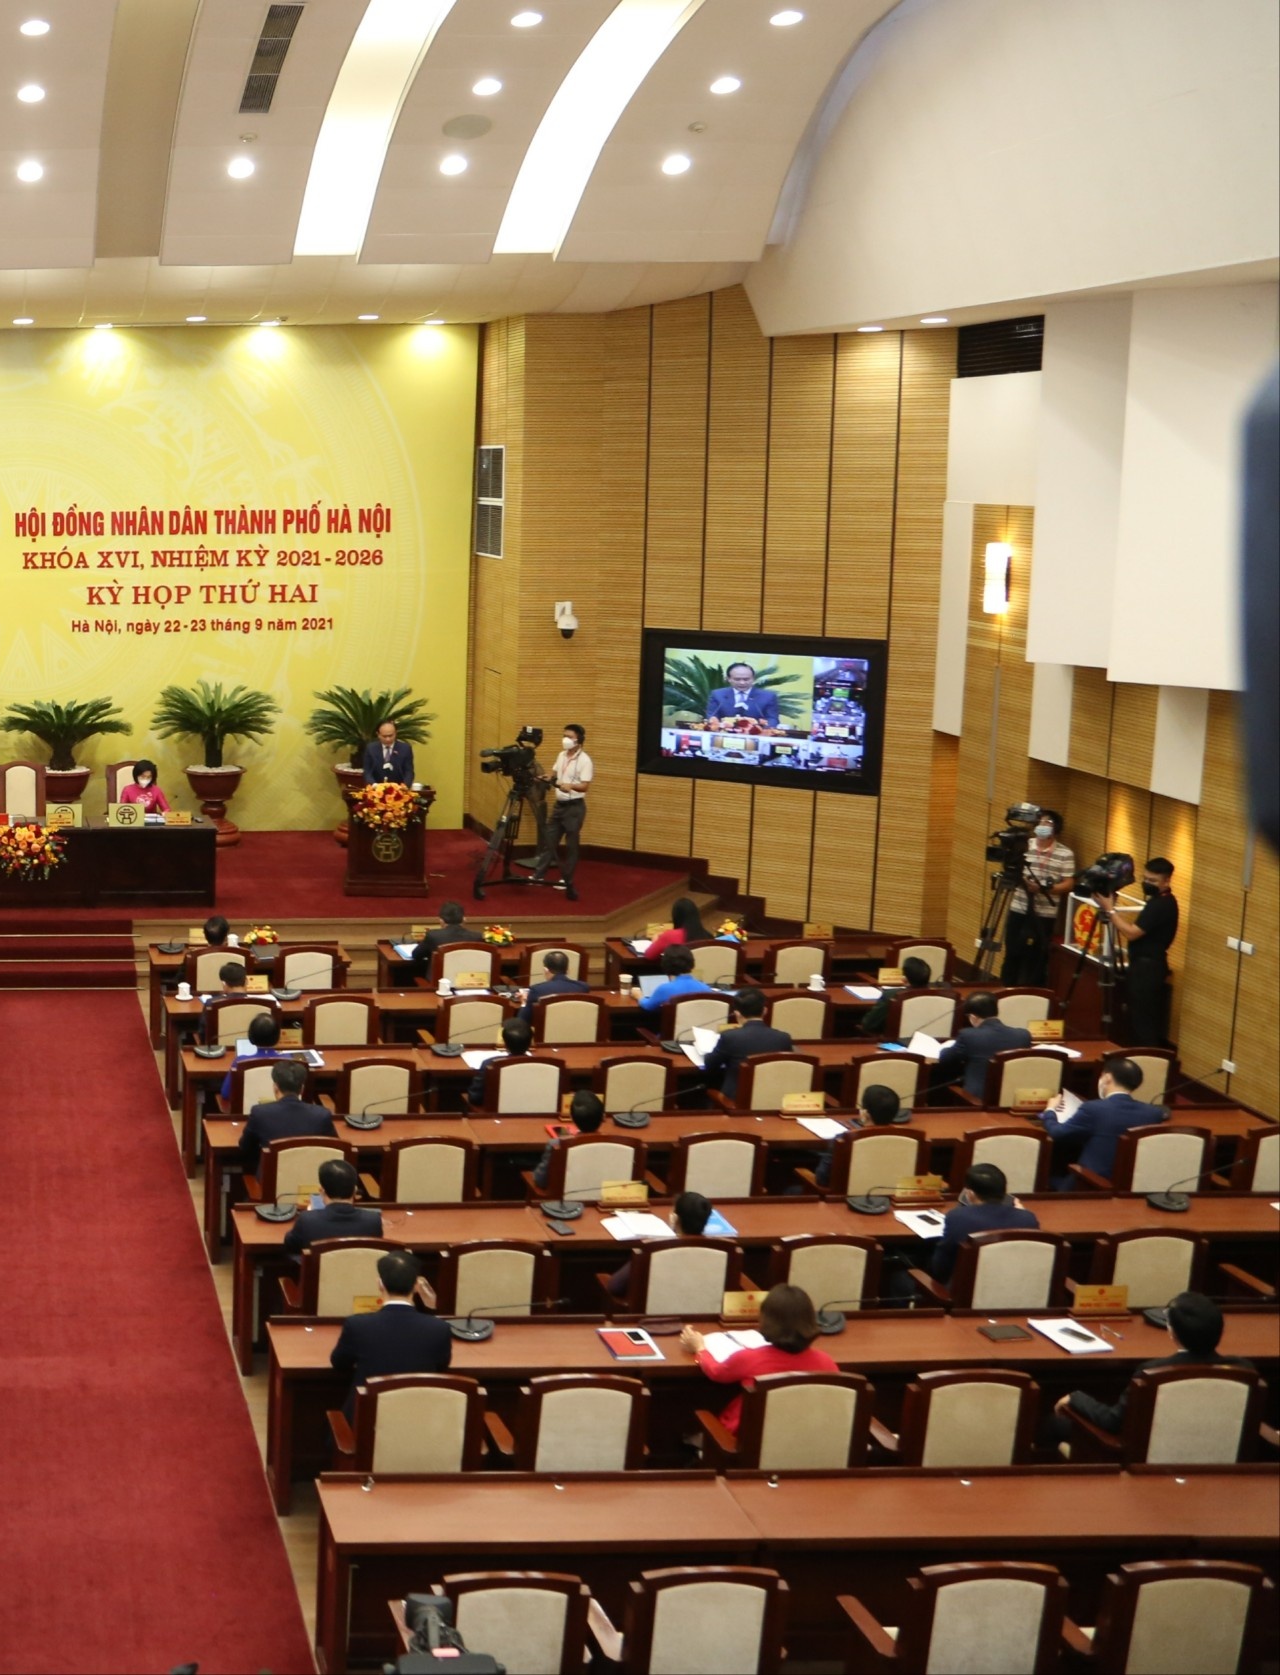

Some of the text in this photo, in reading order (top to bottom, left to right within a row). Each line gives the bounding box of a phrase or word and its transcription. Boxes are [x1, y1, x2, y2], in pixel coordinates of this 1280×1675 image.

[15, 500, 391, 543] HỘI ĐỒNG NHÂN DÂN THÀNH PHỐ HÀ NỘI
[22, 546, 90, 569] KHÓA
[96, 550, 145, 571] XVI,
[150, 544, 230, 572] NHIỆM
[236, 544, 270, 567] KỲ
[86, 578, 319, 610] KỲ HỌP THỨ HAI
[71, 619, 90, 633] Hà
[94, 619, 122, 635] Nội,
[126, 618, 161, 636] ngày
[210, 618, 251, 635] tháng
[254, 618, 264, 631] 9
[267, 618, 298, 632] năm
[301, 617, 334, 631] 2021
